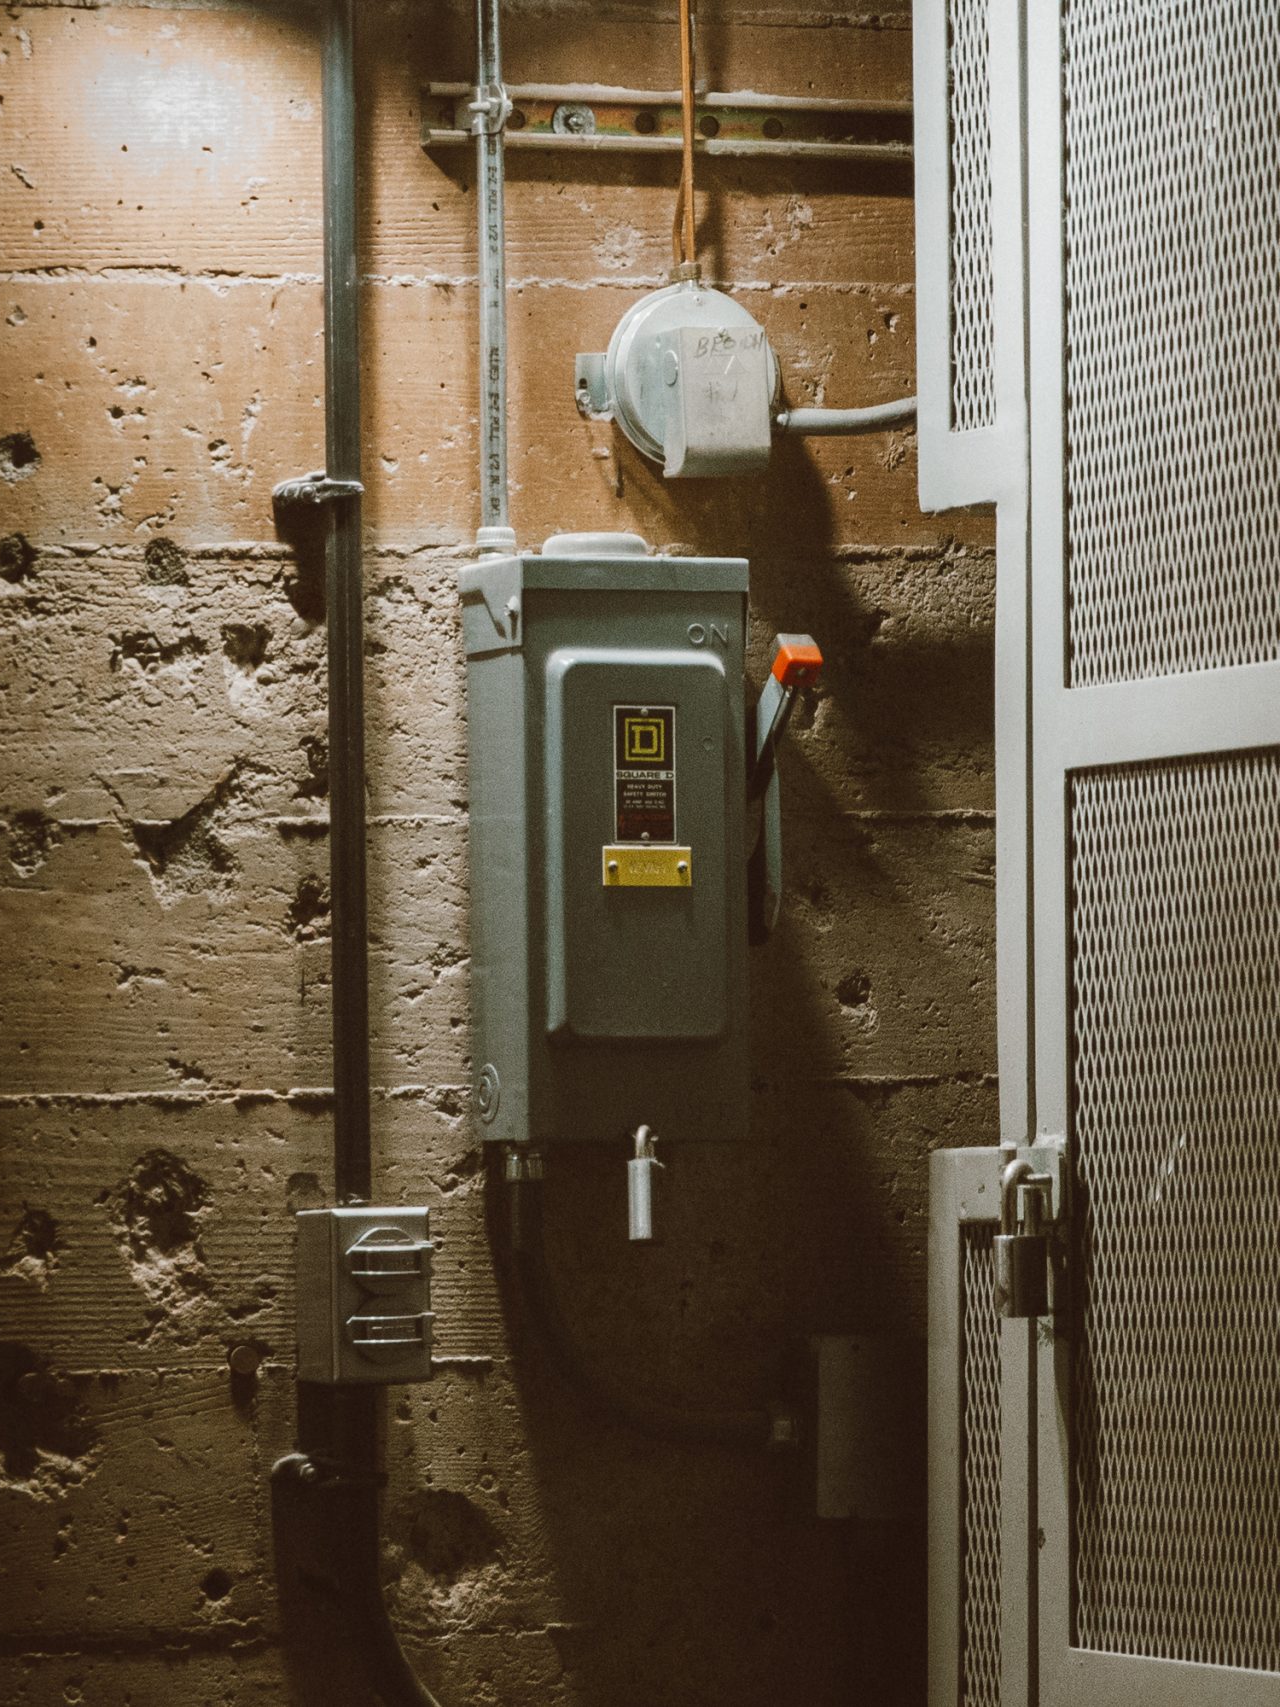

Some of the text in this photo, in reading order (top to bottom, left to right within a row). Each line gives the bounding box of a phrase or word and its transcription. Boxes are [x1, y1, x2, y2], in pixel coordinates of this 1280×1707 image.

[687, 623, 729, 646] ON
[631, 725, 658, 754] D
[616, 771, 675, 779] SQUARE D
